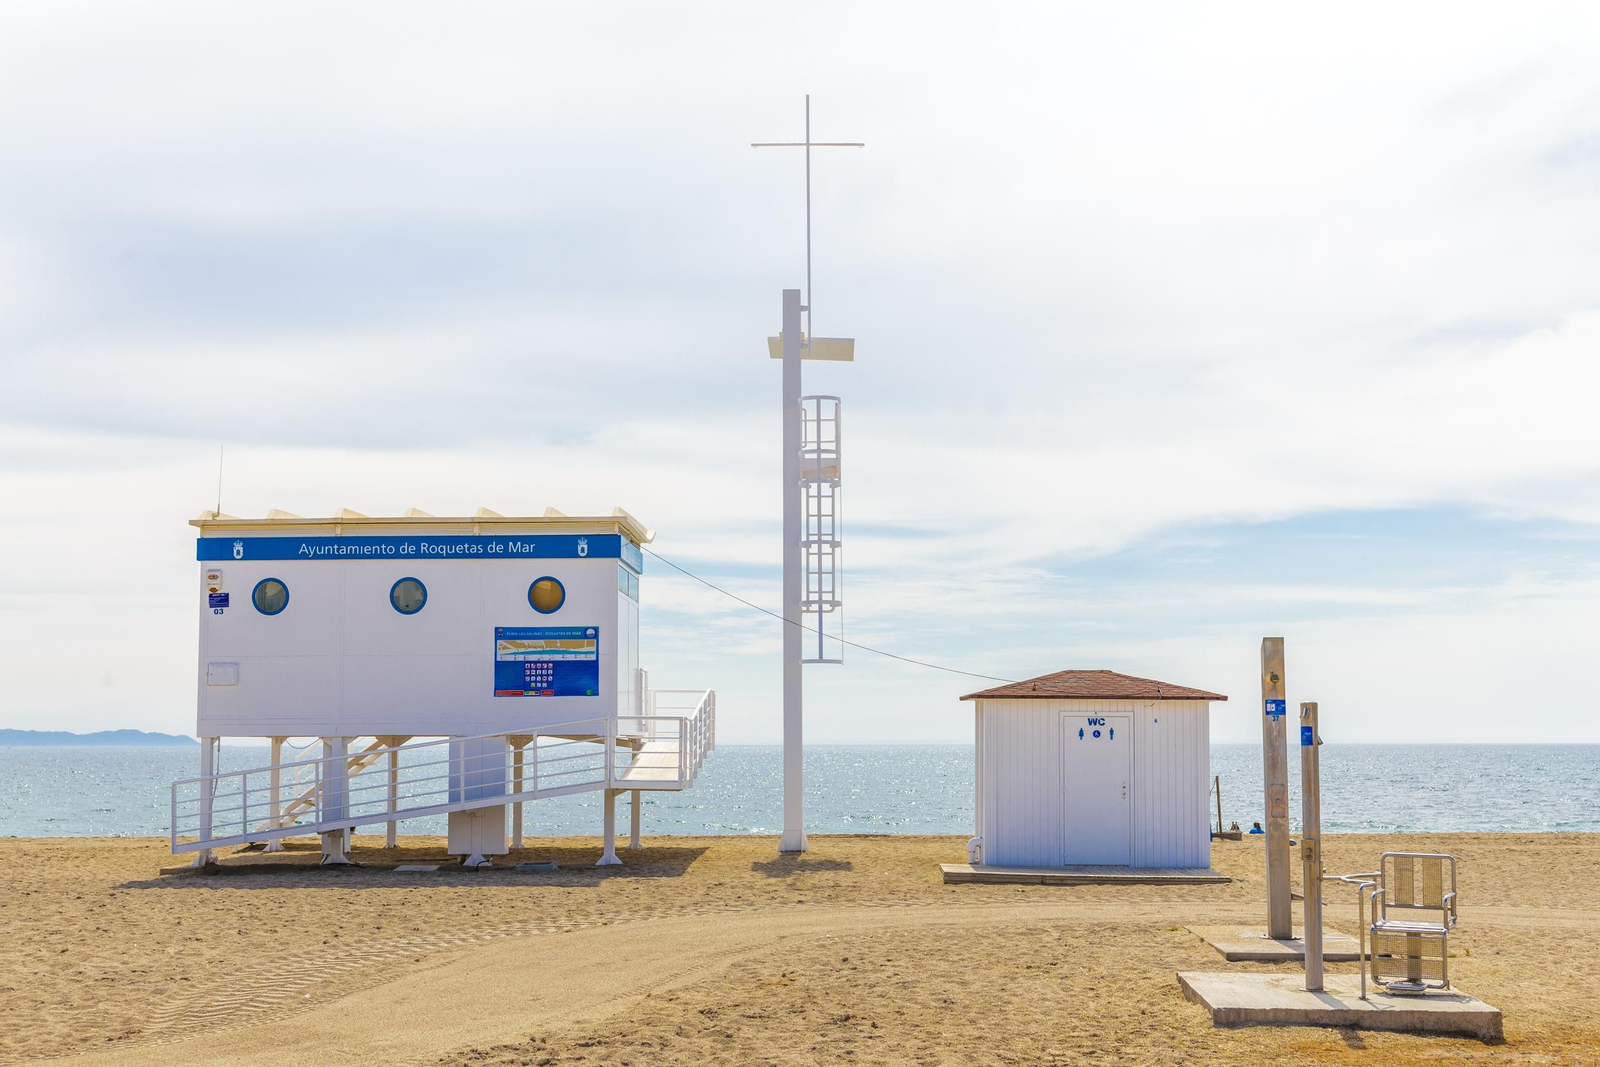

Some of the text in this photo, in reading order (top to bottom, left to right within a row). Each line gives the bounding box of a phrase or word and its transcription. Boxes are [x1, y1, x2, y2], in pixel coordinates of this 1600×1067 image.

[299, 541, 536, 558] Ayuntamiento de Roquetas de Mar
[1087, 717, 1106, 726] WC
